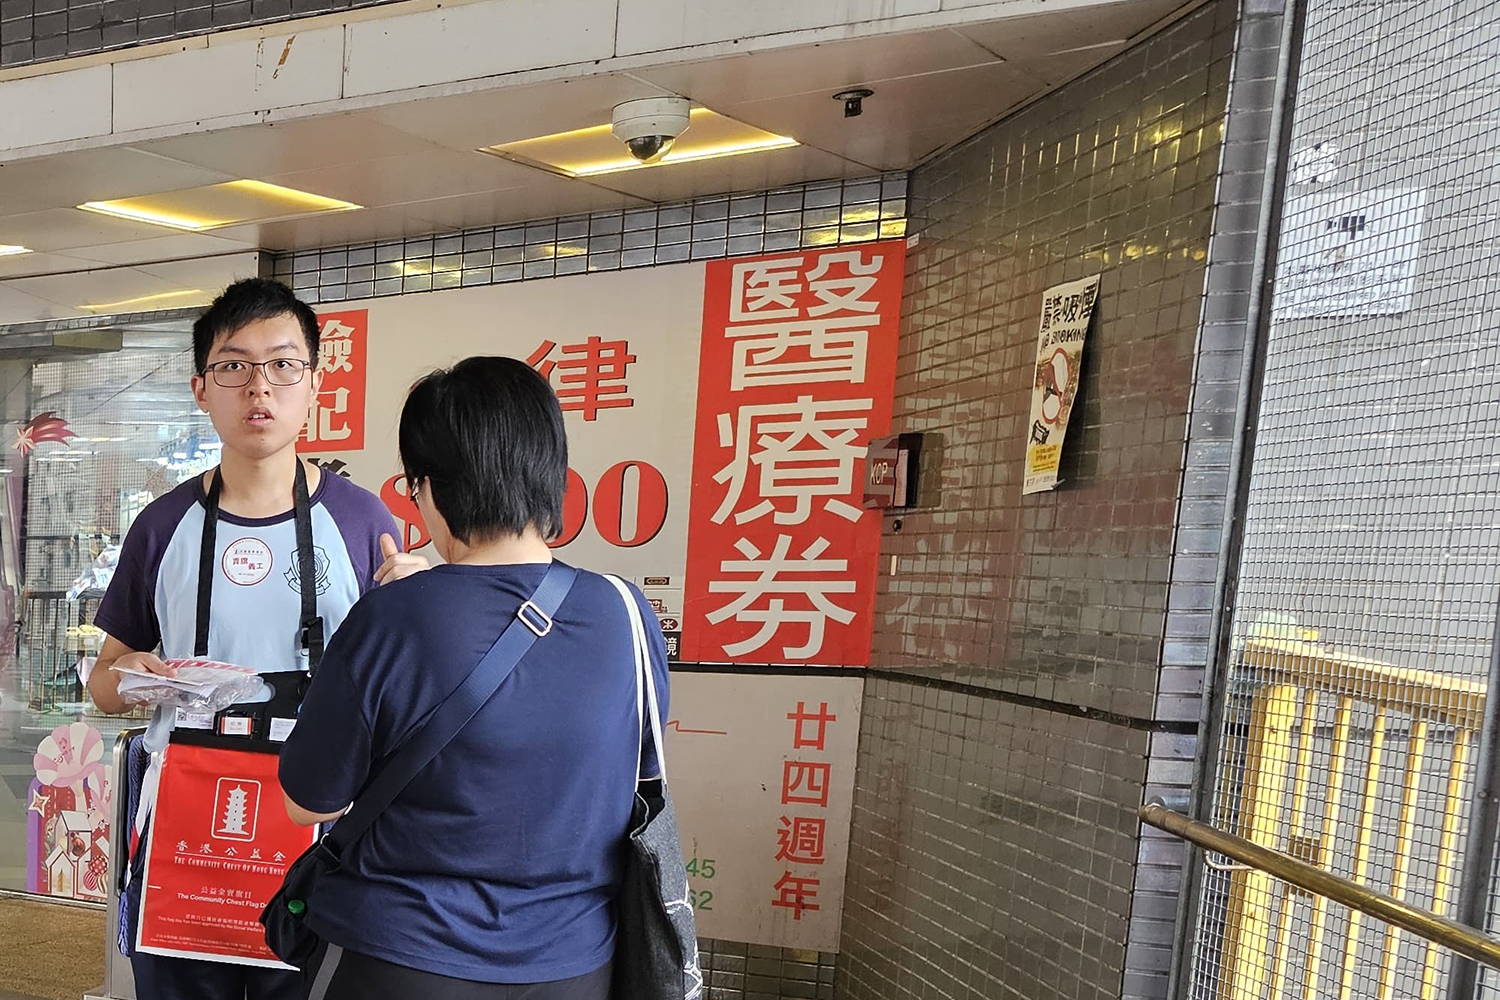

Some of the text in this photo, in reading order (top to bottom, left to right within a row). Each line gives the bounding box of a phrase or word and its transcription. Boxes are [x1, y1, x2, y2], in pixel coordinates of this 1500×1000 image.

[771, 701, 837, 921] 廿四週年
[177, 892, 189, 900] The
[190, 894, 225, 905] Community
[226, 898, 245, 906] Chest
[246, 900, 259, 909] Flag
